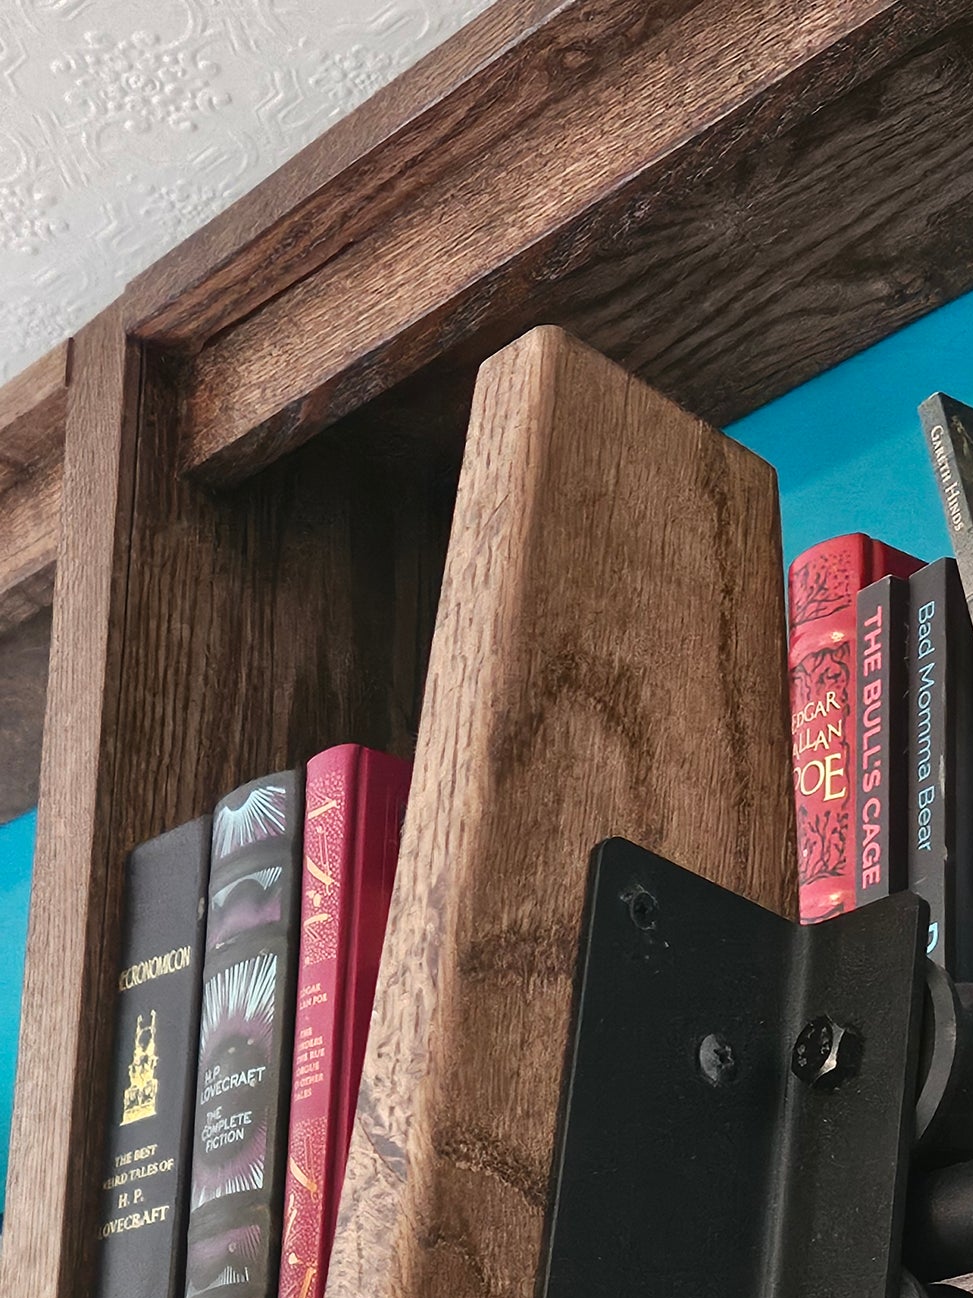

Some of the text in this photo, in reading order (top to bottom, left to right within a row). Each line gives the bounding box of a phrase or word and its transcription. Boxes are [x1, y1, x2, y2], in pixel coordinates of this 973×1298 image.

[791, 691, 841, 735] EDGAR
[916, 600, 935, 852] Bad Momma Bear
[793, 719, 842, 760] ALLAN
[861, 605, 883, 890] THE BULL'S CAGE
[117, 945, 192, 992] ECRONOMICON
[200, 1066, 266, 1106] LOVECRAFT
[201, 1111, 253, 1142] COMPLETE
[206, 1106, 222, 1124] THE
[115, 1143, 158, 1168] THE BEST
[205, 1128, 245, 1154] FICTION
[129, 1162, 158, 1181] TALES
[159, 1158, 174, 1173] OF
